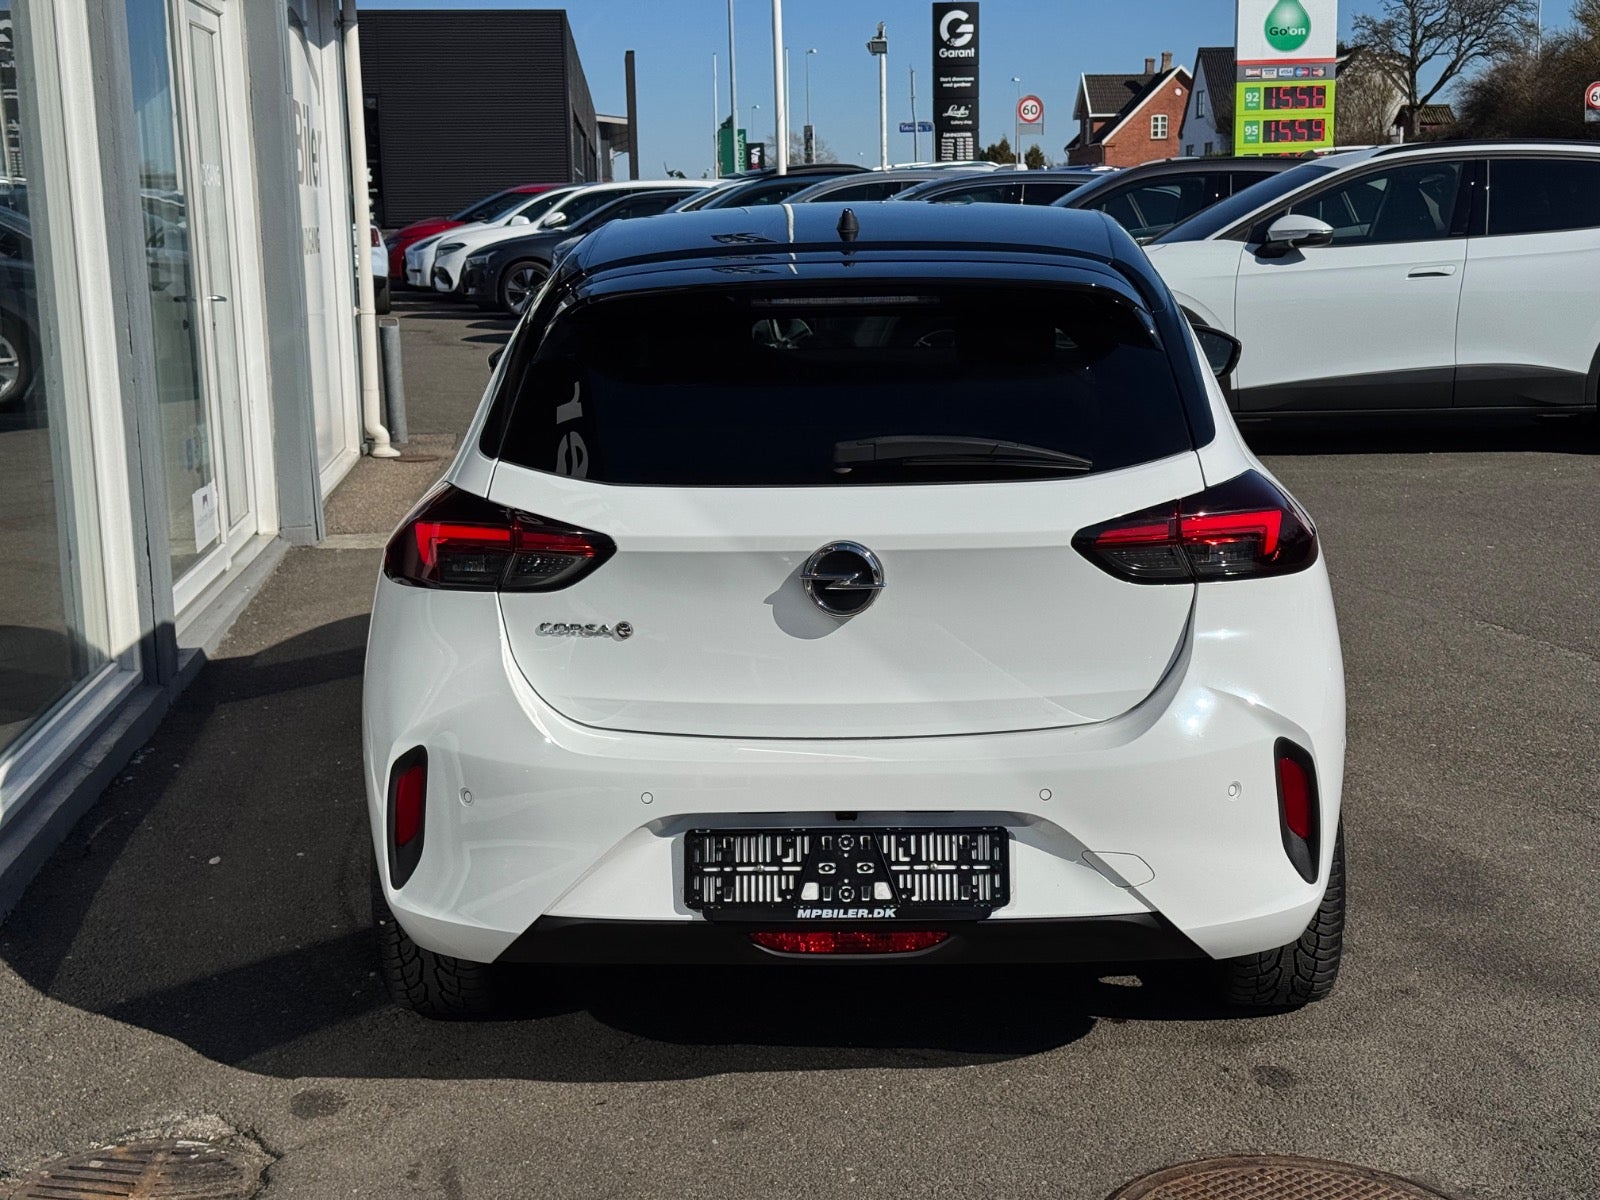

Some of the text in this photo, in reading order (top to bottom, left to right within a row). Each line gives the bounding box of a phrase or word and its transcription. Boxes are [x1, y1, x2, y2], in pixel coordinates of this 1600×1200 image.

[939, 48, 975, 58] Garant
[1245, 92, 1259, 102] 92
[1022, 104, 1038, 115] 60
[1244, 125, 1258, 135] 95
[538, 621, 611, 636] CORSA
[797, 908, 896, 918] MPBILER.DK
